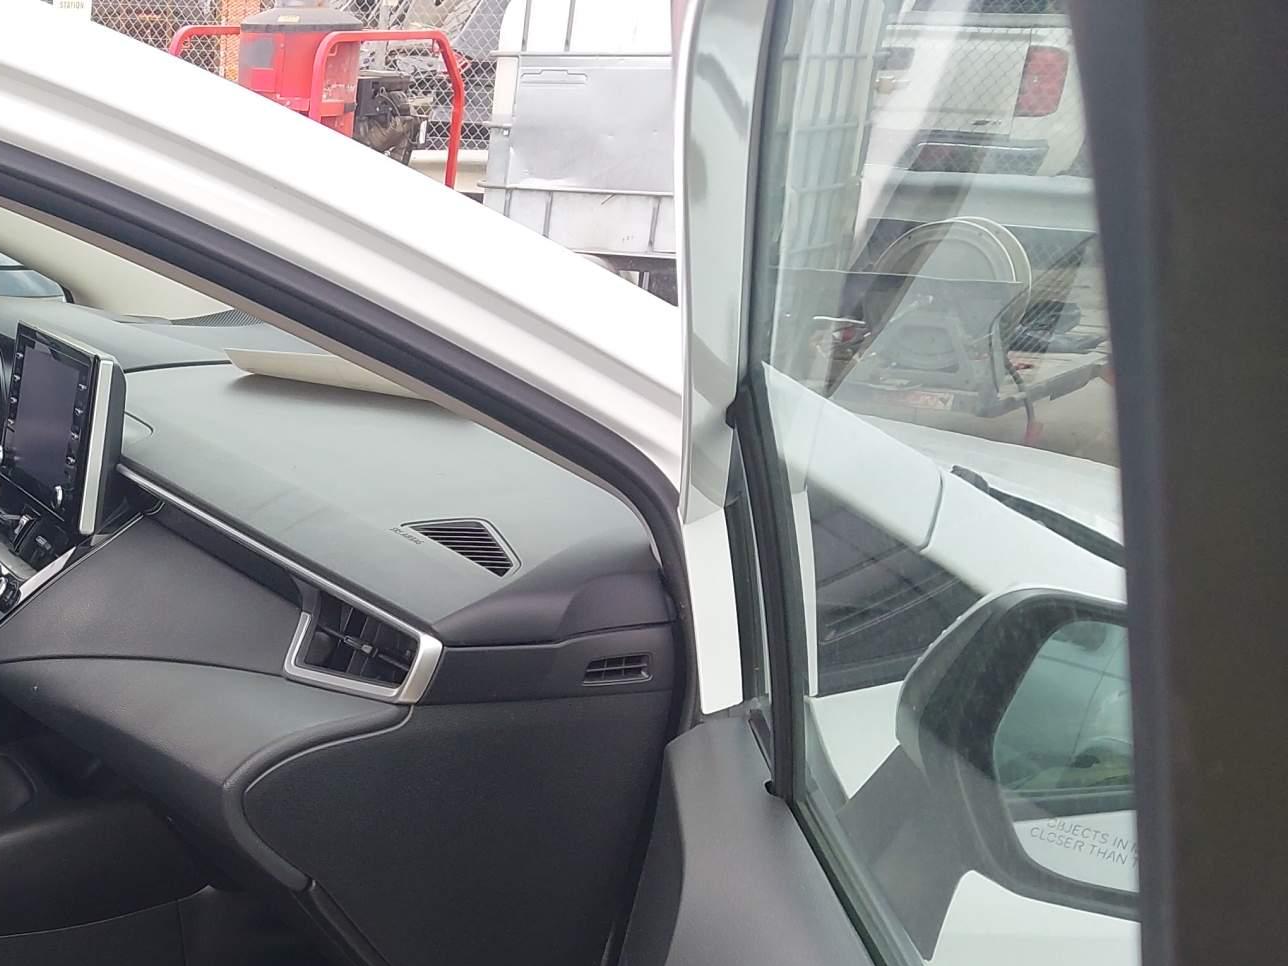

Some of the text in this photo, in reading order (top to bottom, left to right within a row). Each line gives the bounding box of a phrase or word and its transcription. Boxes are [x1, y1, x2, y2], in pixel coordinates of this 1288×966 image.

[1030, 827, 1085, 852] CLOSER
[1089, 844, 1128, 865] THAN
[1047, 818, 1110, 844] OBJECTS
[1113, 837, 1129, 850] IN
